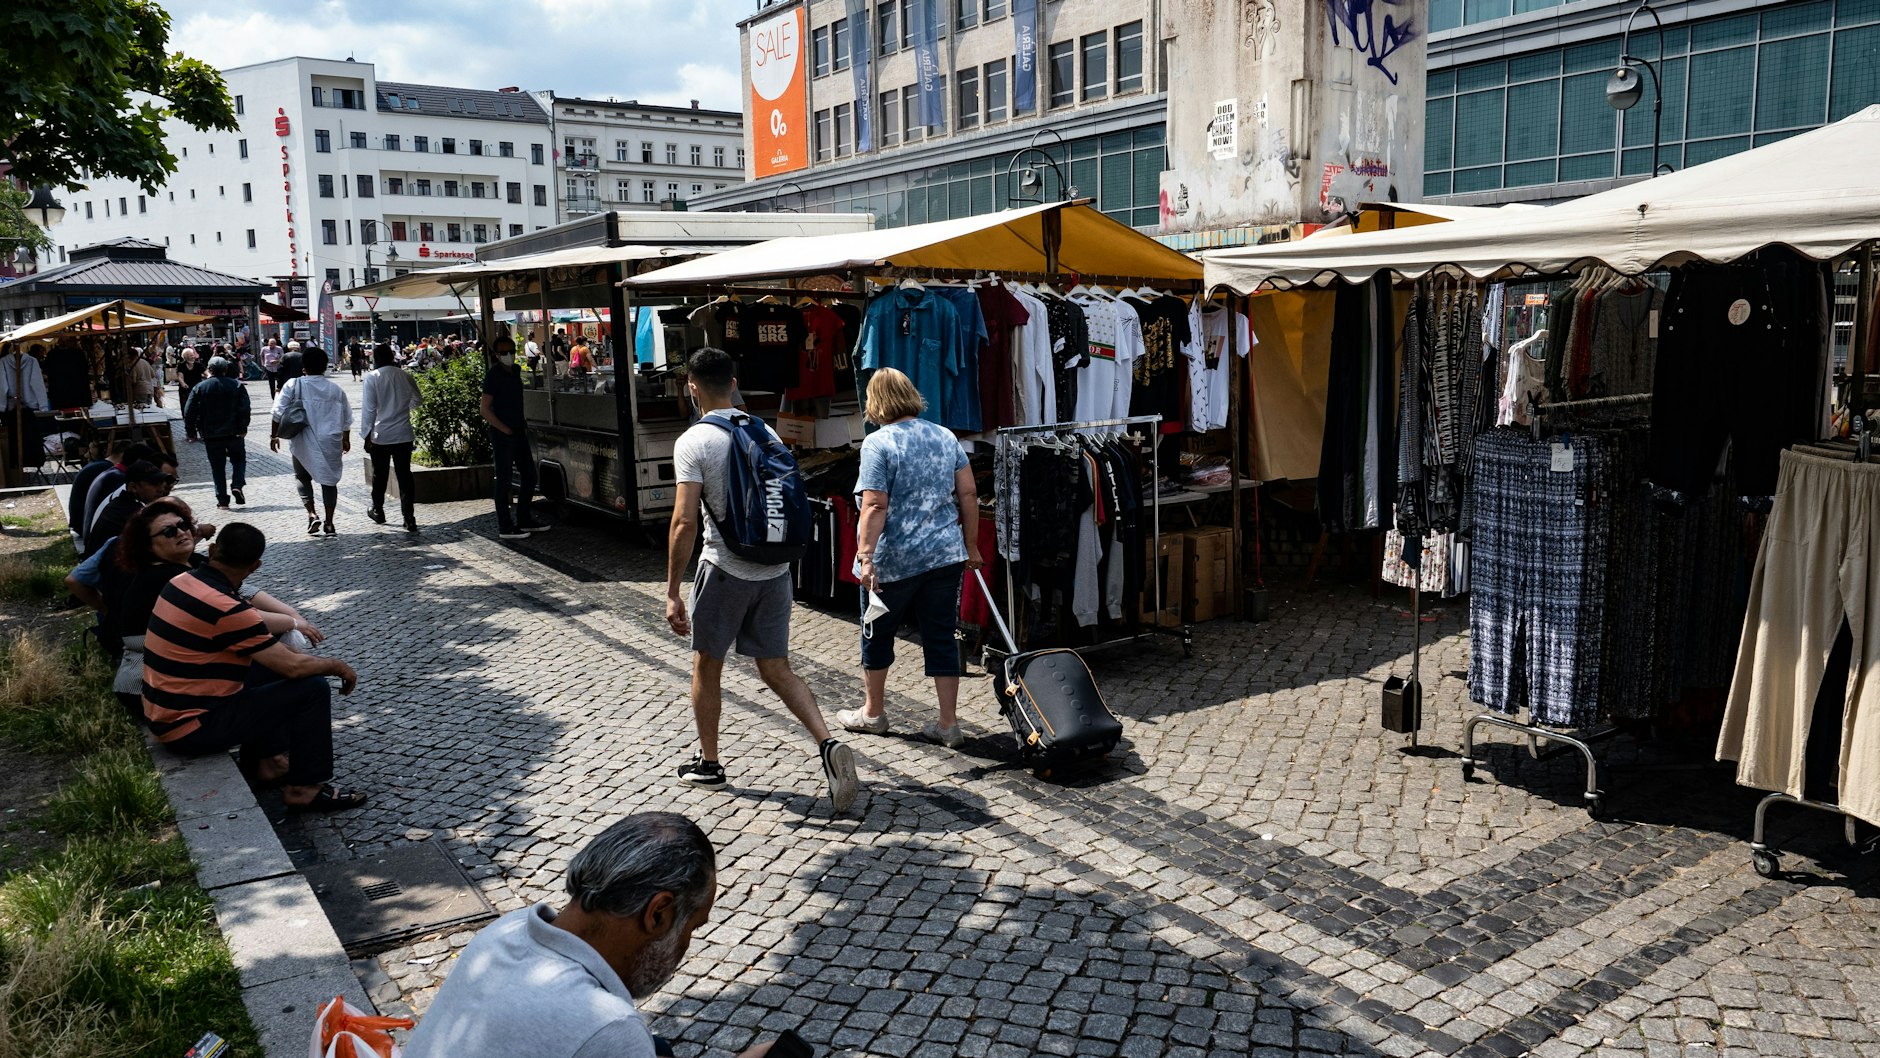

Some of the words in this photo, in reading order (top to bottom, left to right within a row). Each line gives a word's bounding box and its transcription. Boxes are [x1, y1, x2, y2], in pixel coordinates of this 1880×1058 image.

[756, 22, 791, 66] SALE
[1217, 103, 1233, 115] OOD
[1214, 113, 1235, 123] YSTEM
[1213, 136, 1233, 147] NOW!
[771, 155, 789, 165] GALERIA
[434, 250, 475, 259] Sparkasse
[758, 324, 787, 334] KRZ
[758, 333, 788, 343] BRG
[1088, 345, 1102, 354] OR
[765, 478, 785, 518] PUMA
